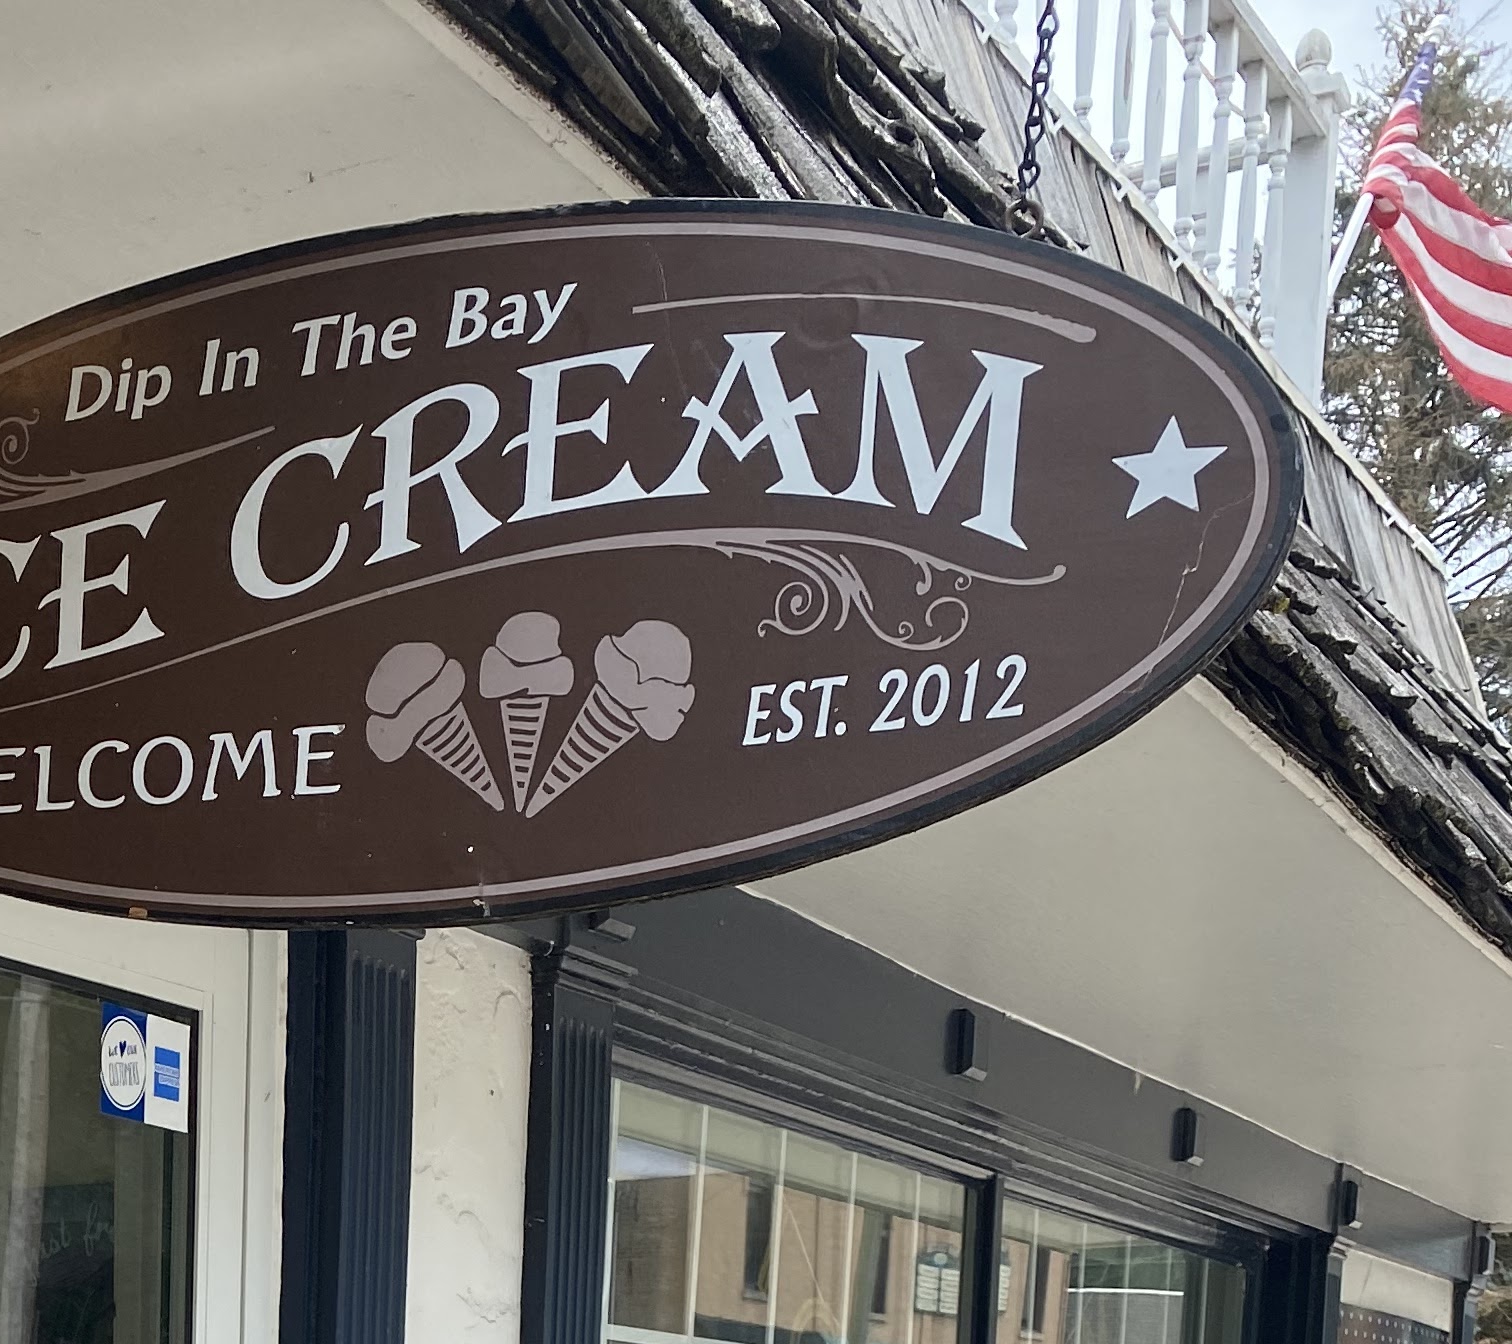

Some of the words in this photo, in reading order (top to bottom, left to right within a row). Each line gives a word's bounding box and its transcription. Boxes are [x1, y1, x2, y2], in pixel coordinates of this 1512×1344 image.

[64, 357, 173, 422] Dip
[199, 338, 261, 397] In
[292, 311, 418, 377] The
[445, 282, 579, 349] Bay
[230, 331, 1045, 600] CREAM
[742, 674, 849, 747] EST.
[877, 653, 1029, 734] 2012
